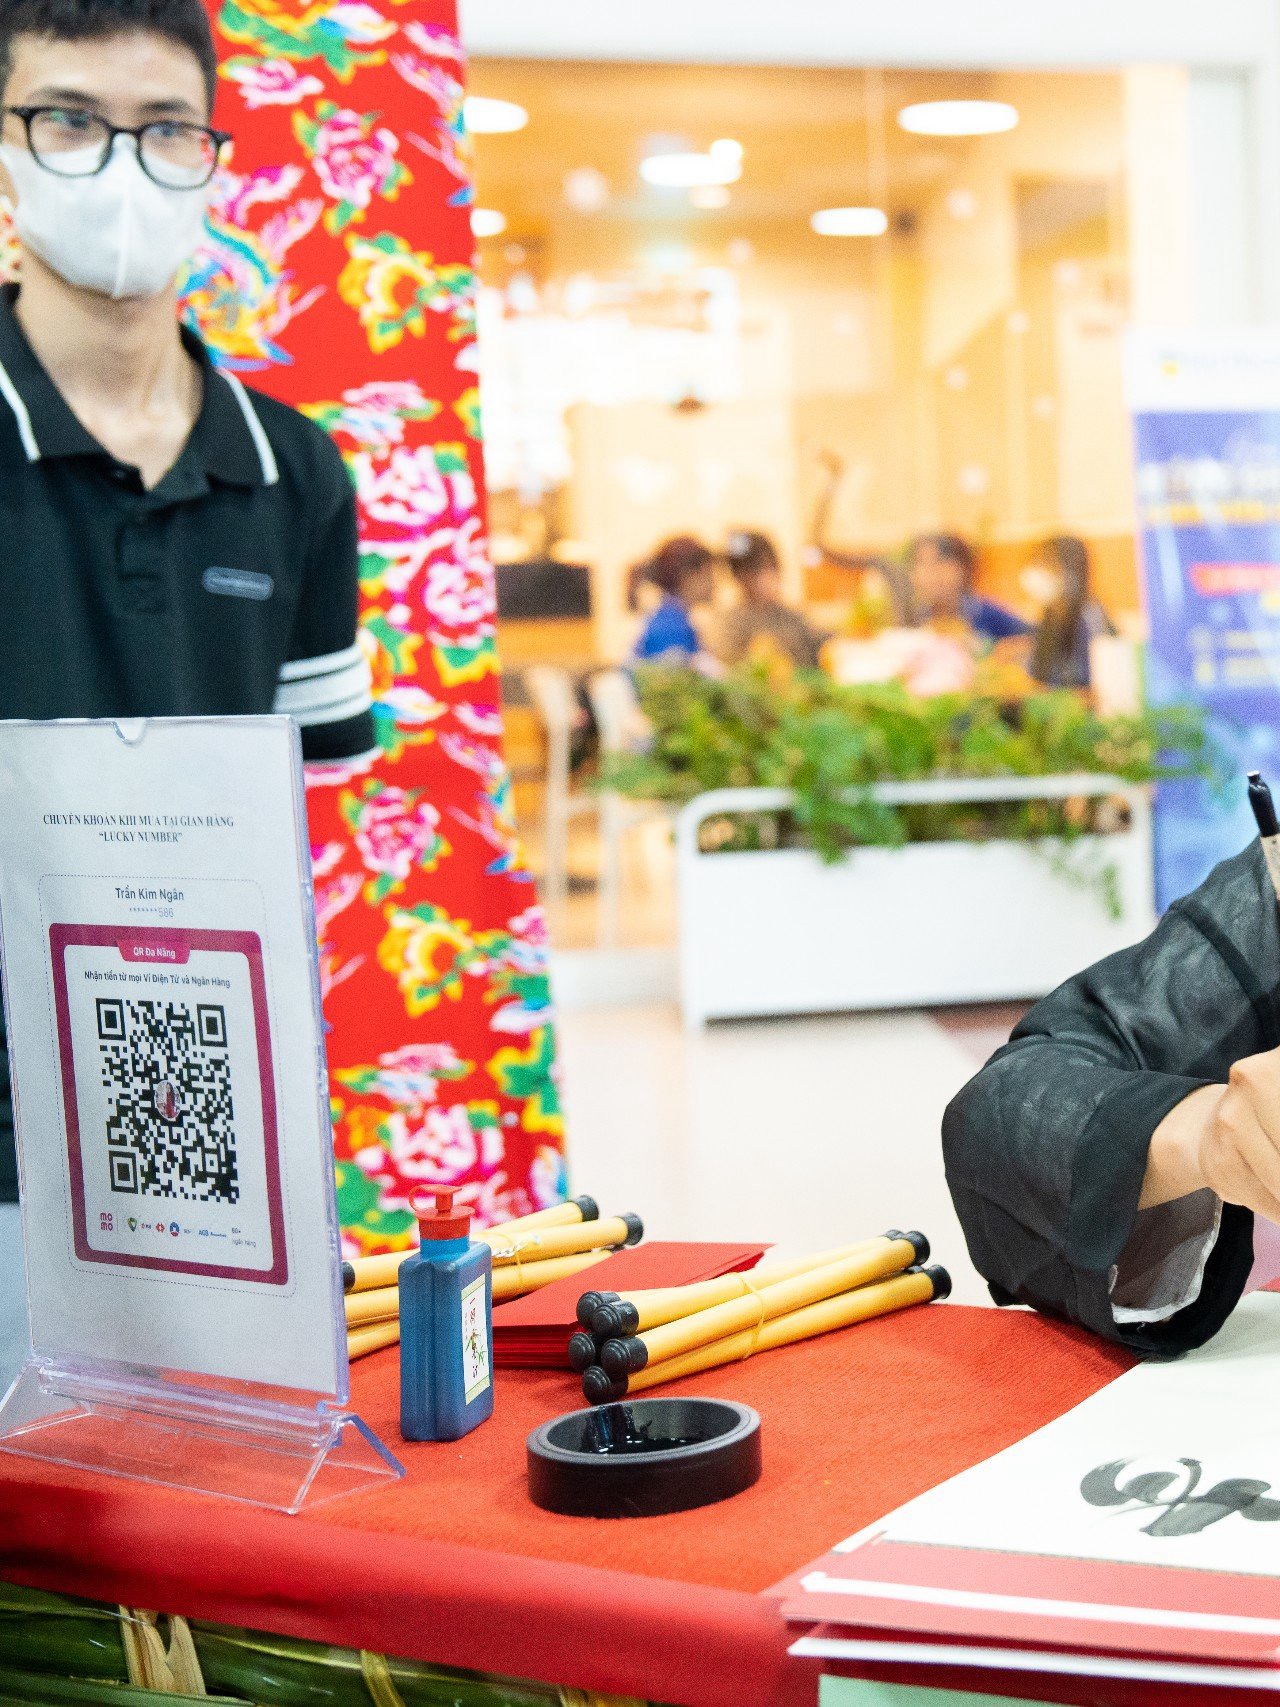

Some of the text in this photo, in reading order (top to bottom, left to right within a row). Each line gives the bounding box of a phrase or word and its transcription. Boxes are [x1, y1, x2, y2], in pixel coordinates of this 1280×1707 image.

[43, 812, 81, 825] CHUYỂN
[119, 814, 136, 825] KHI
[138, 815, 161, 826] MUA
[163, 815, 178, 828] TẠI
[180, 815, 204, 827] GIAN
[206, 813, 234, 827] HÀNG
[115, 885, 184, 903] Trần Kim Ngân
[133, 947, 176, 959] QR Đa Năng
[84, 971, 103, 981] Nhận
[128, 974, 142, 983] mọi
[152, 974, 168, 985] Điện
[181, 974, 190, 984] và
[191, 976, 210, 987] Ngân
[211, 977, 231, 988] Hàng
